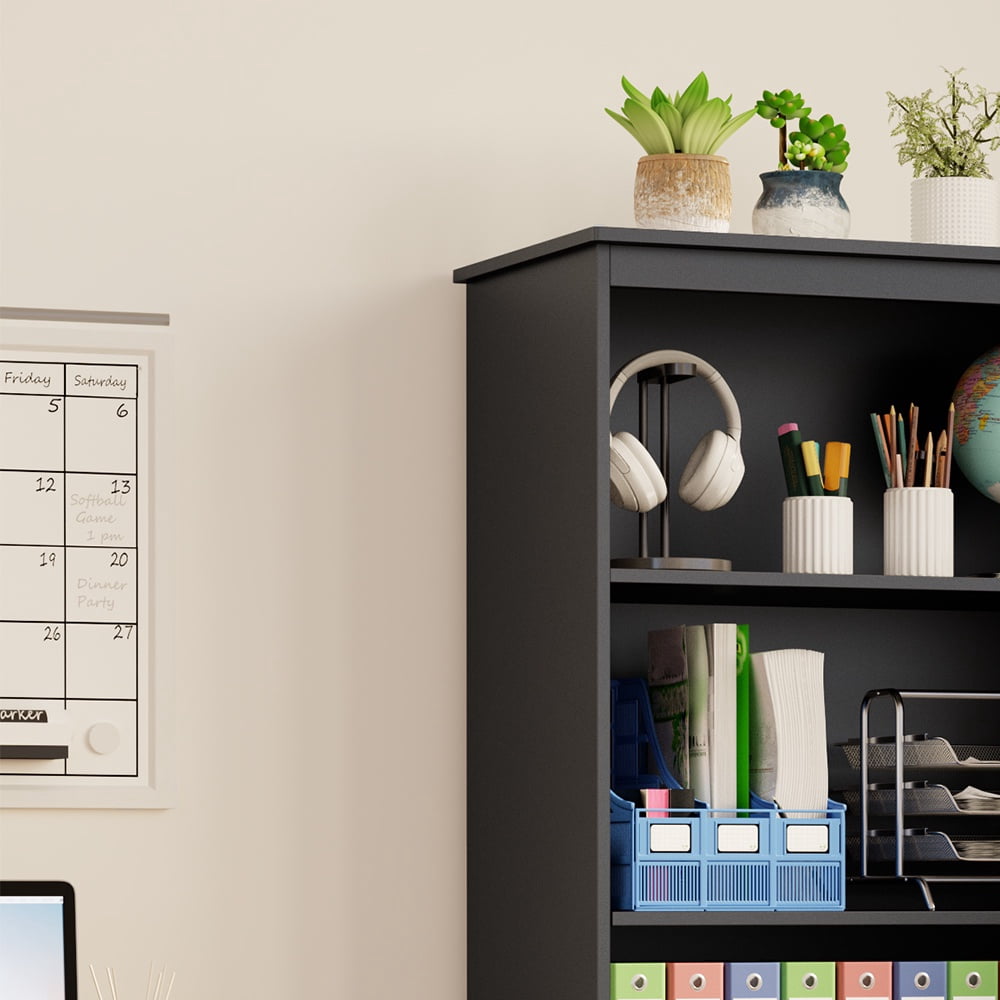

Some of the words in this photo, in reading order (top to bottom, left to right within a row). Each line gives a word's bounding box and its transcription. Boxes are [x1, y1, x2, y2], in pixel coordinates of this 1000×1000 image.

[4, 371, 52, 388] Friday
[74, 374, 127, 391] Saturday
[48, 398, 63, 413] 5
[116, 403, 129, 418] 6
[35, 477, 57, 493] 12
[111, 479, 131, 495] 13
[70, 493, 127, 509] Softball
[75, 511, 117, 524] Game
[87, 530, 96, 542] 1
[100, 532, 125, 545] pm
[39, 552, 57, 568] 19
[110, 552, 129, 568] 20
[77, 578, 128, 590] Dinner
[77, 595, 115, 612] Party
[43, 625, 61, 641] 26
[113, 624, 134, 640] 27
[0, 709, 44, 721] arker
